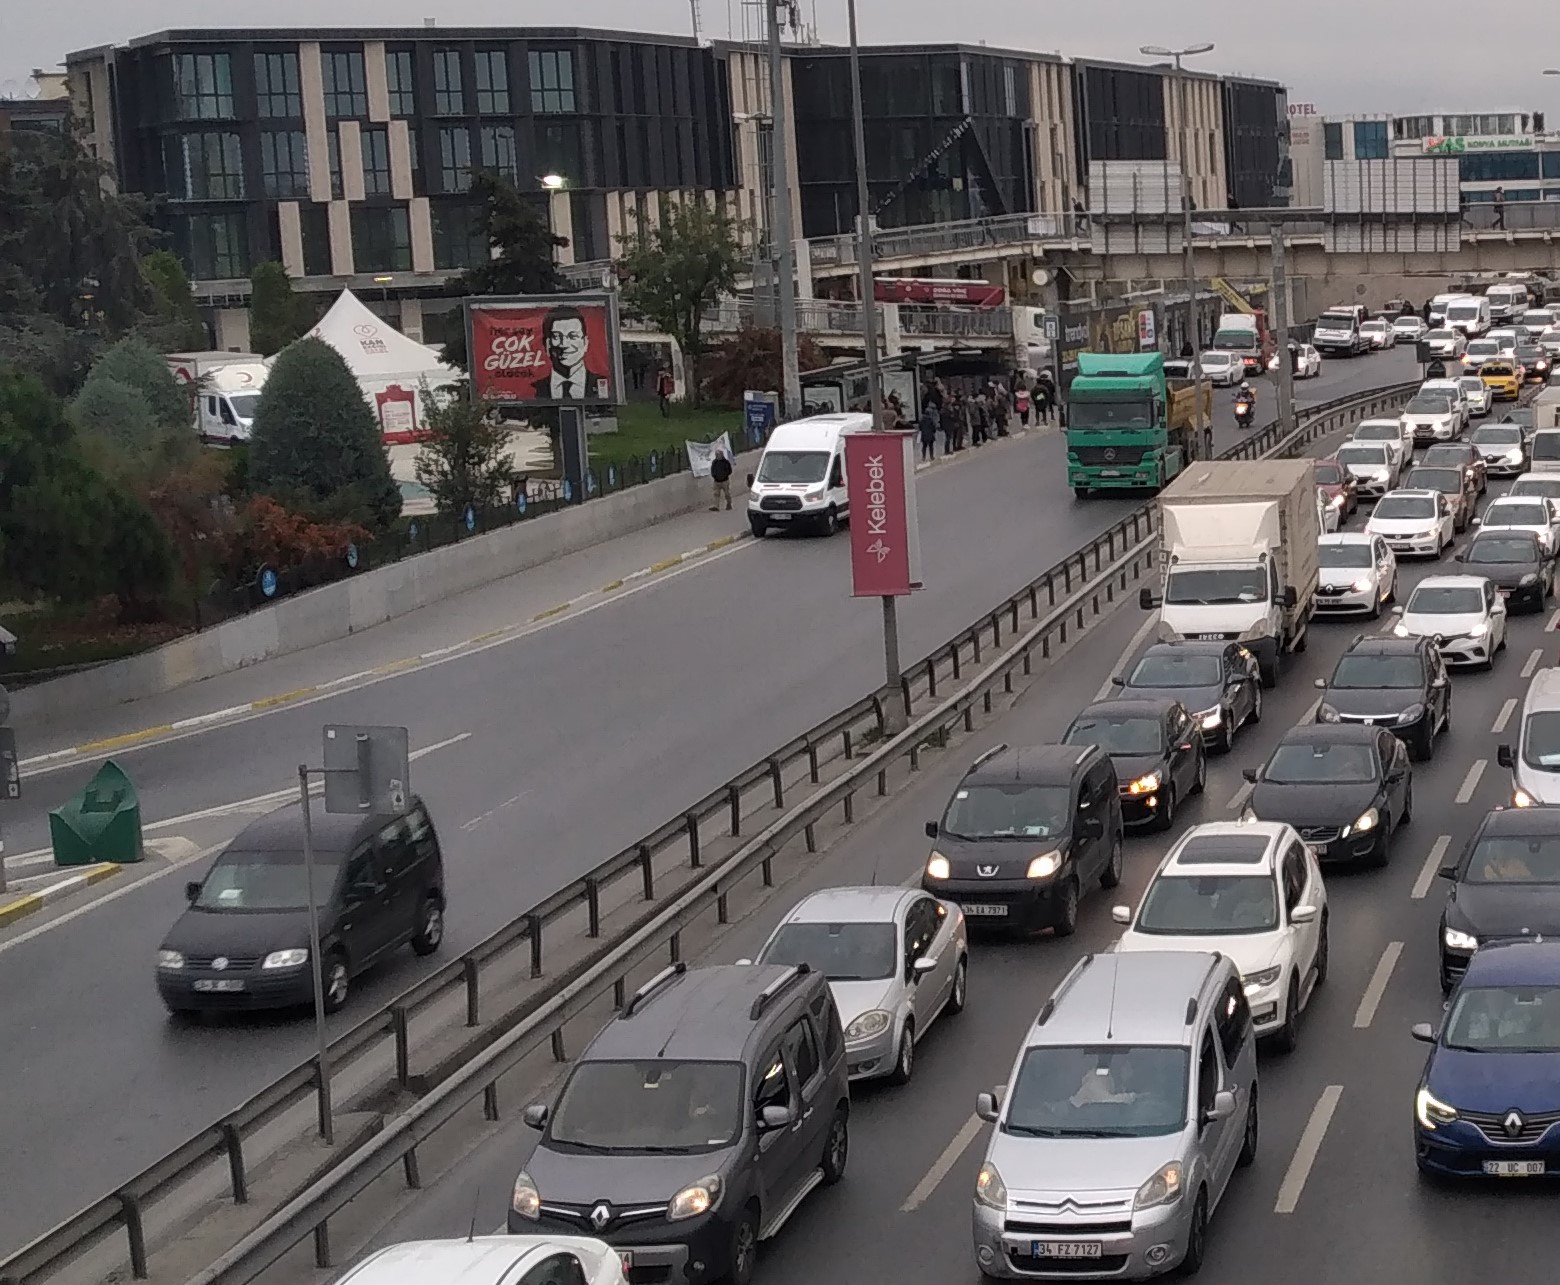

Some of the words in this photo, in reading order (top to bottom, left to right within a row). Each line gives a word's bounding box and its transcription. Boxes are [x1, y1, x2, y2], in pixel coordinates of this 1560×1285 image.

[491, 335, 535, 355] ÇOK
[484, 350, 546, 371] GÜZEL
[865, 454, 887, 535] Kelebek
[1488, 1163, 1500, 1172] 22
[1526, 1163, 1543, 1172] 007
[1039, 1244, 1052, 1254] 34
[1058, 1244, 1071, 1255] FZ
[1074, 1244, 1099, 1255] 7127
